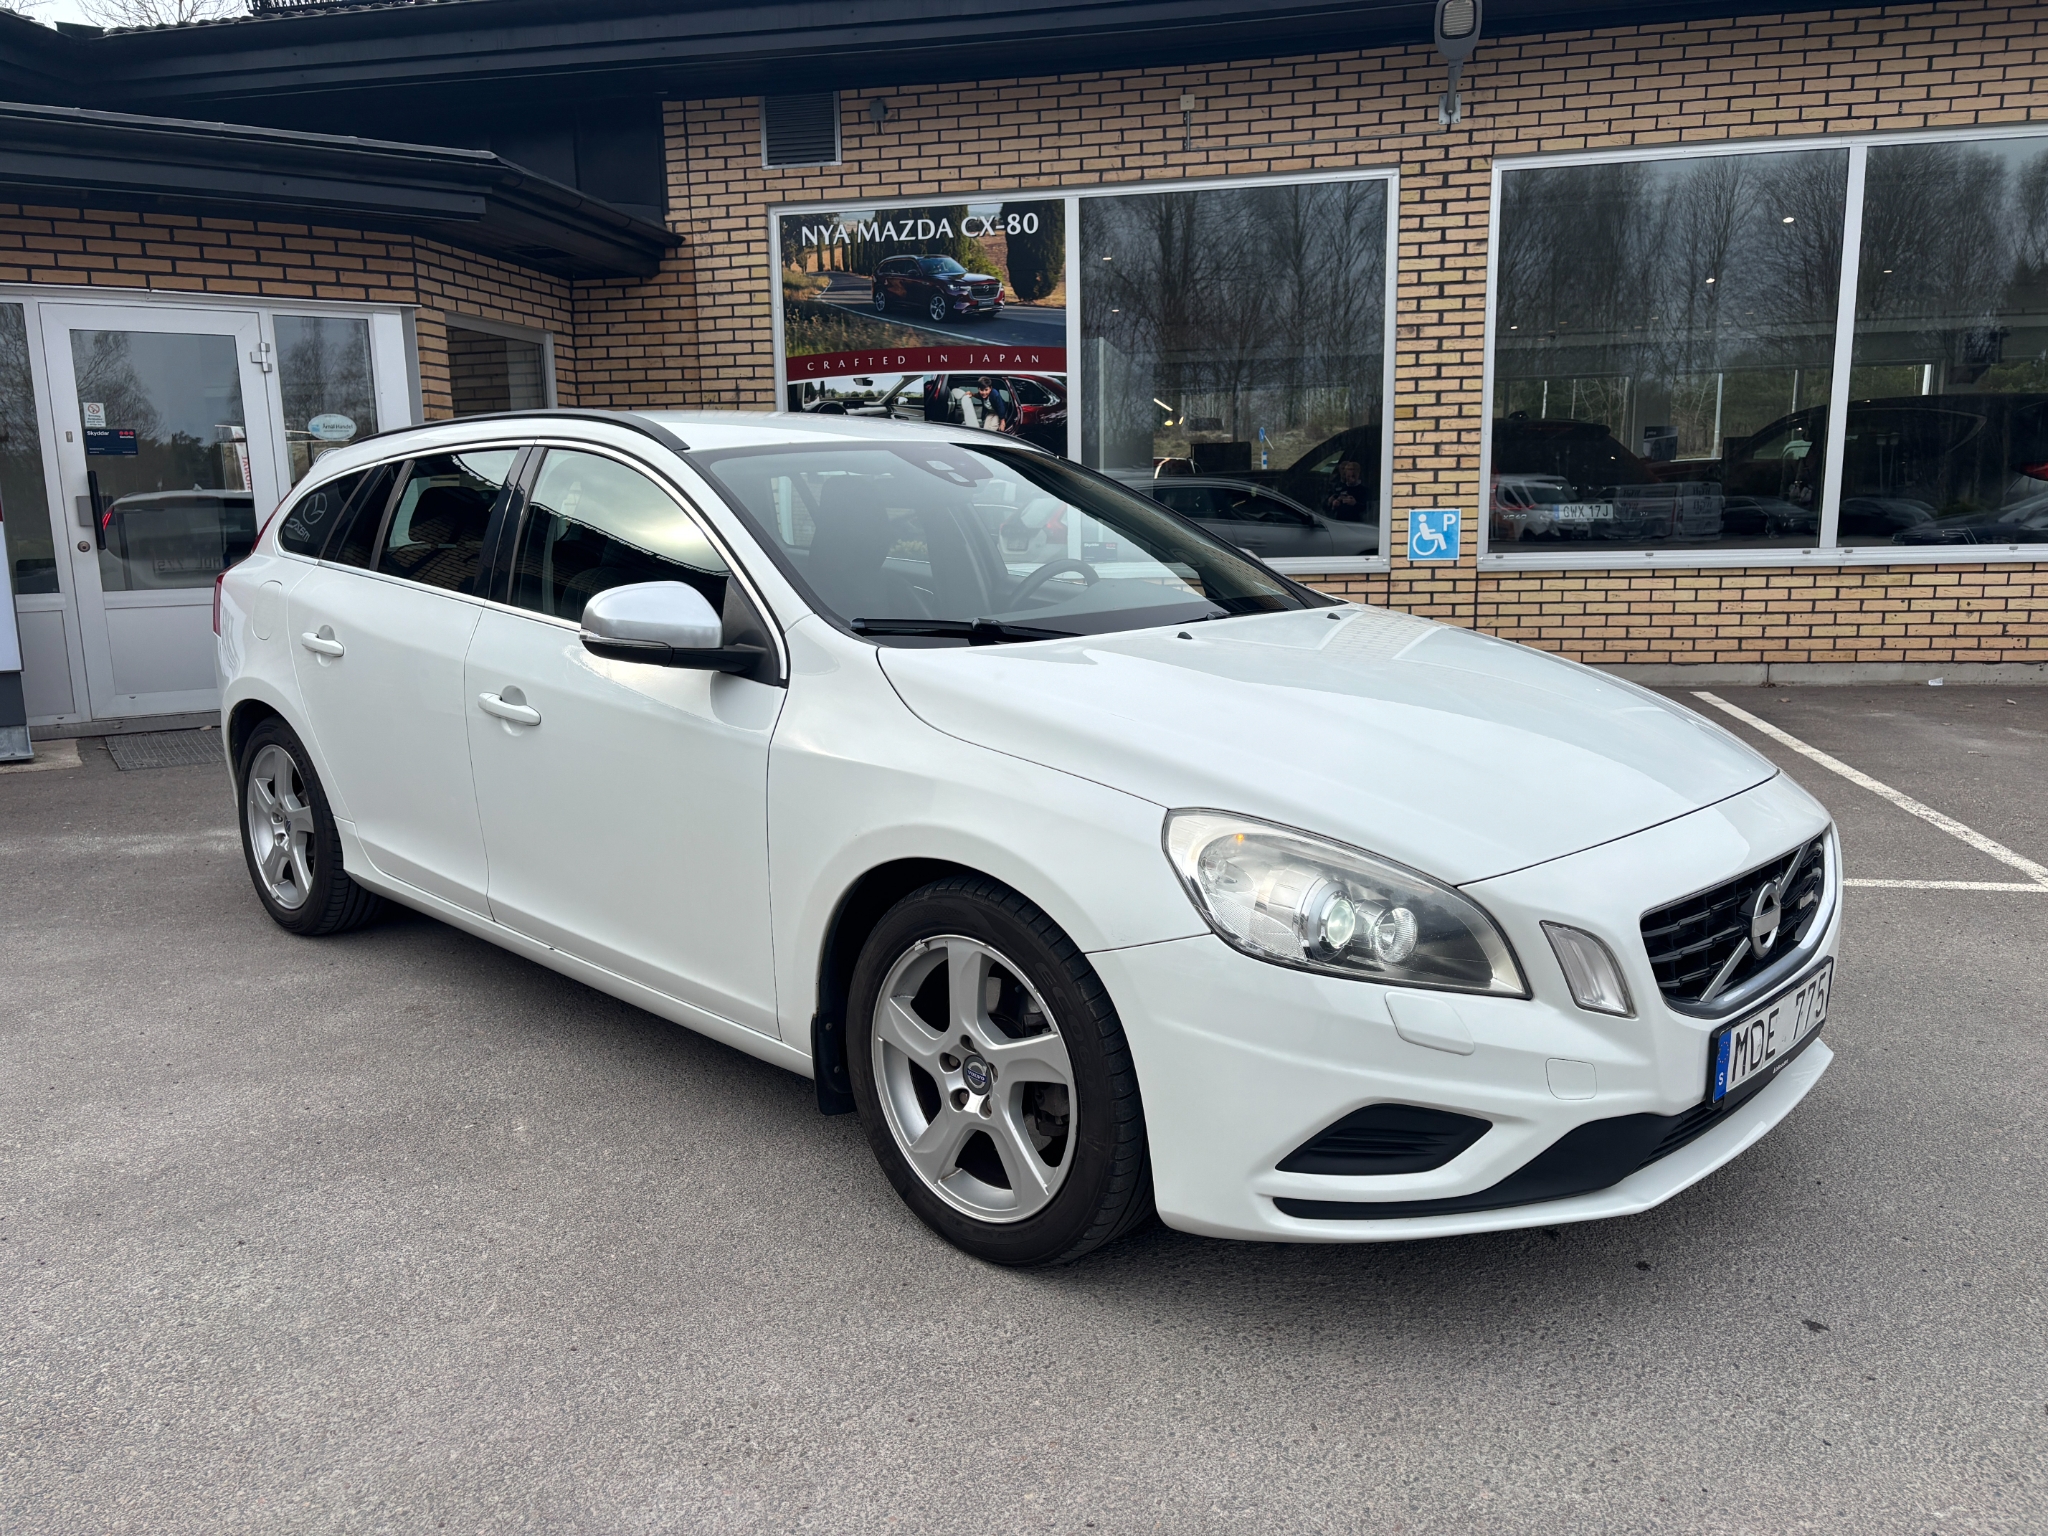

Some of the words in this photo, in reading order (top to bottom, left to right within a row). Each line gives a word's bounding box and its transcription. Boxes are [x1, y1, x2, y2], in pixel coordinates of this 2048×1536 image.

[802, 224, 850, 246] NYA
[857, 218, 954, 243] MAZDA
[961, 212, 1039, 237] CX-80
[807, 355, 906, 371] CRAFTED
[927, 354, 948, 363] IN
[970, 354, 1039, 364] JAPAN
[1563, 505, 1585, 518] GWX
[1588, 505, 1609, 518] 17J
[1443, 513, 1457, 531] P
[1731, 1007, 1780, 1083] MDE
[1793, 971, 1827, 1041] 775
[967, 1070, 985, 1081] VOLVO
[1718, 1072, 1724, 1086] S
